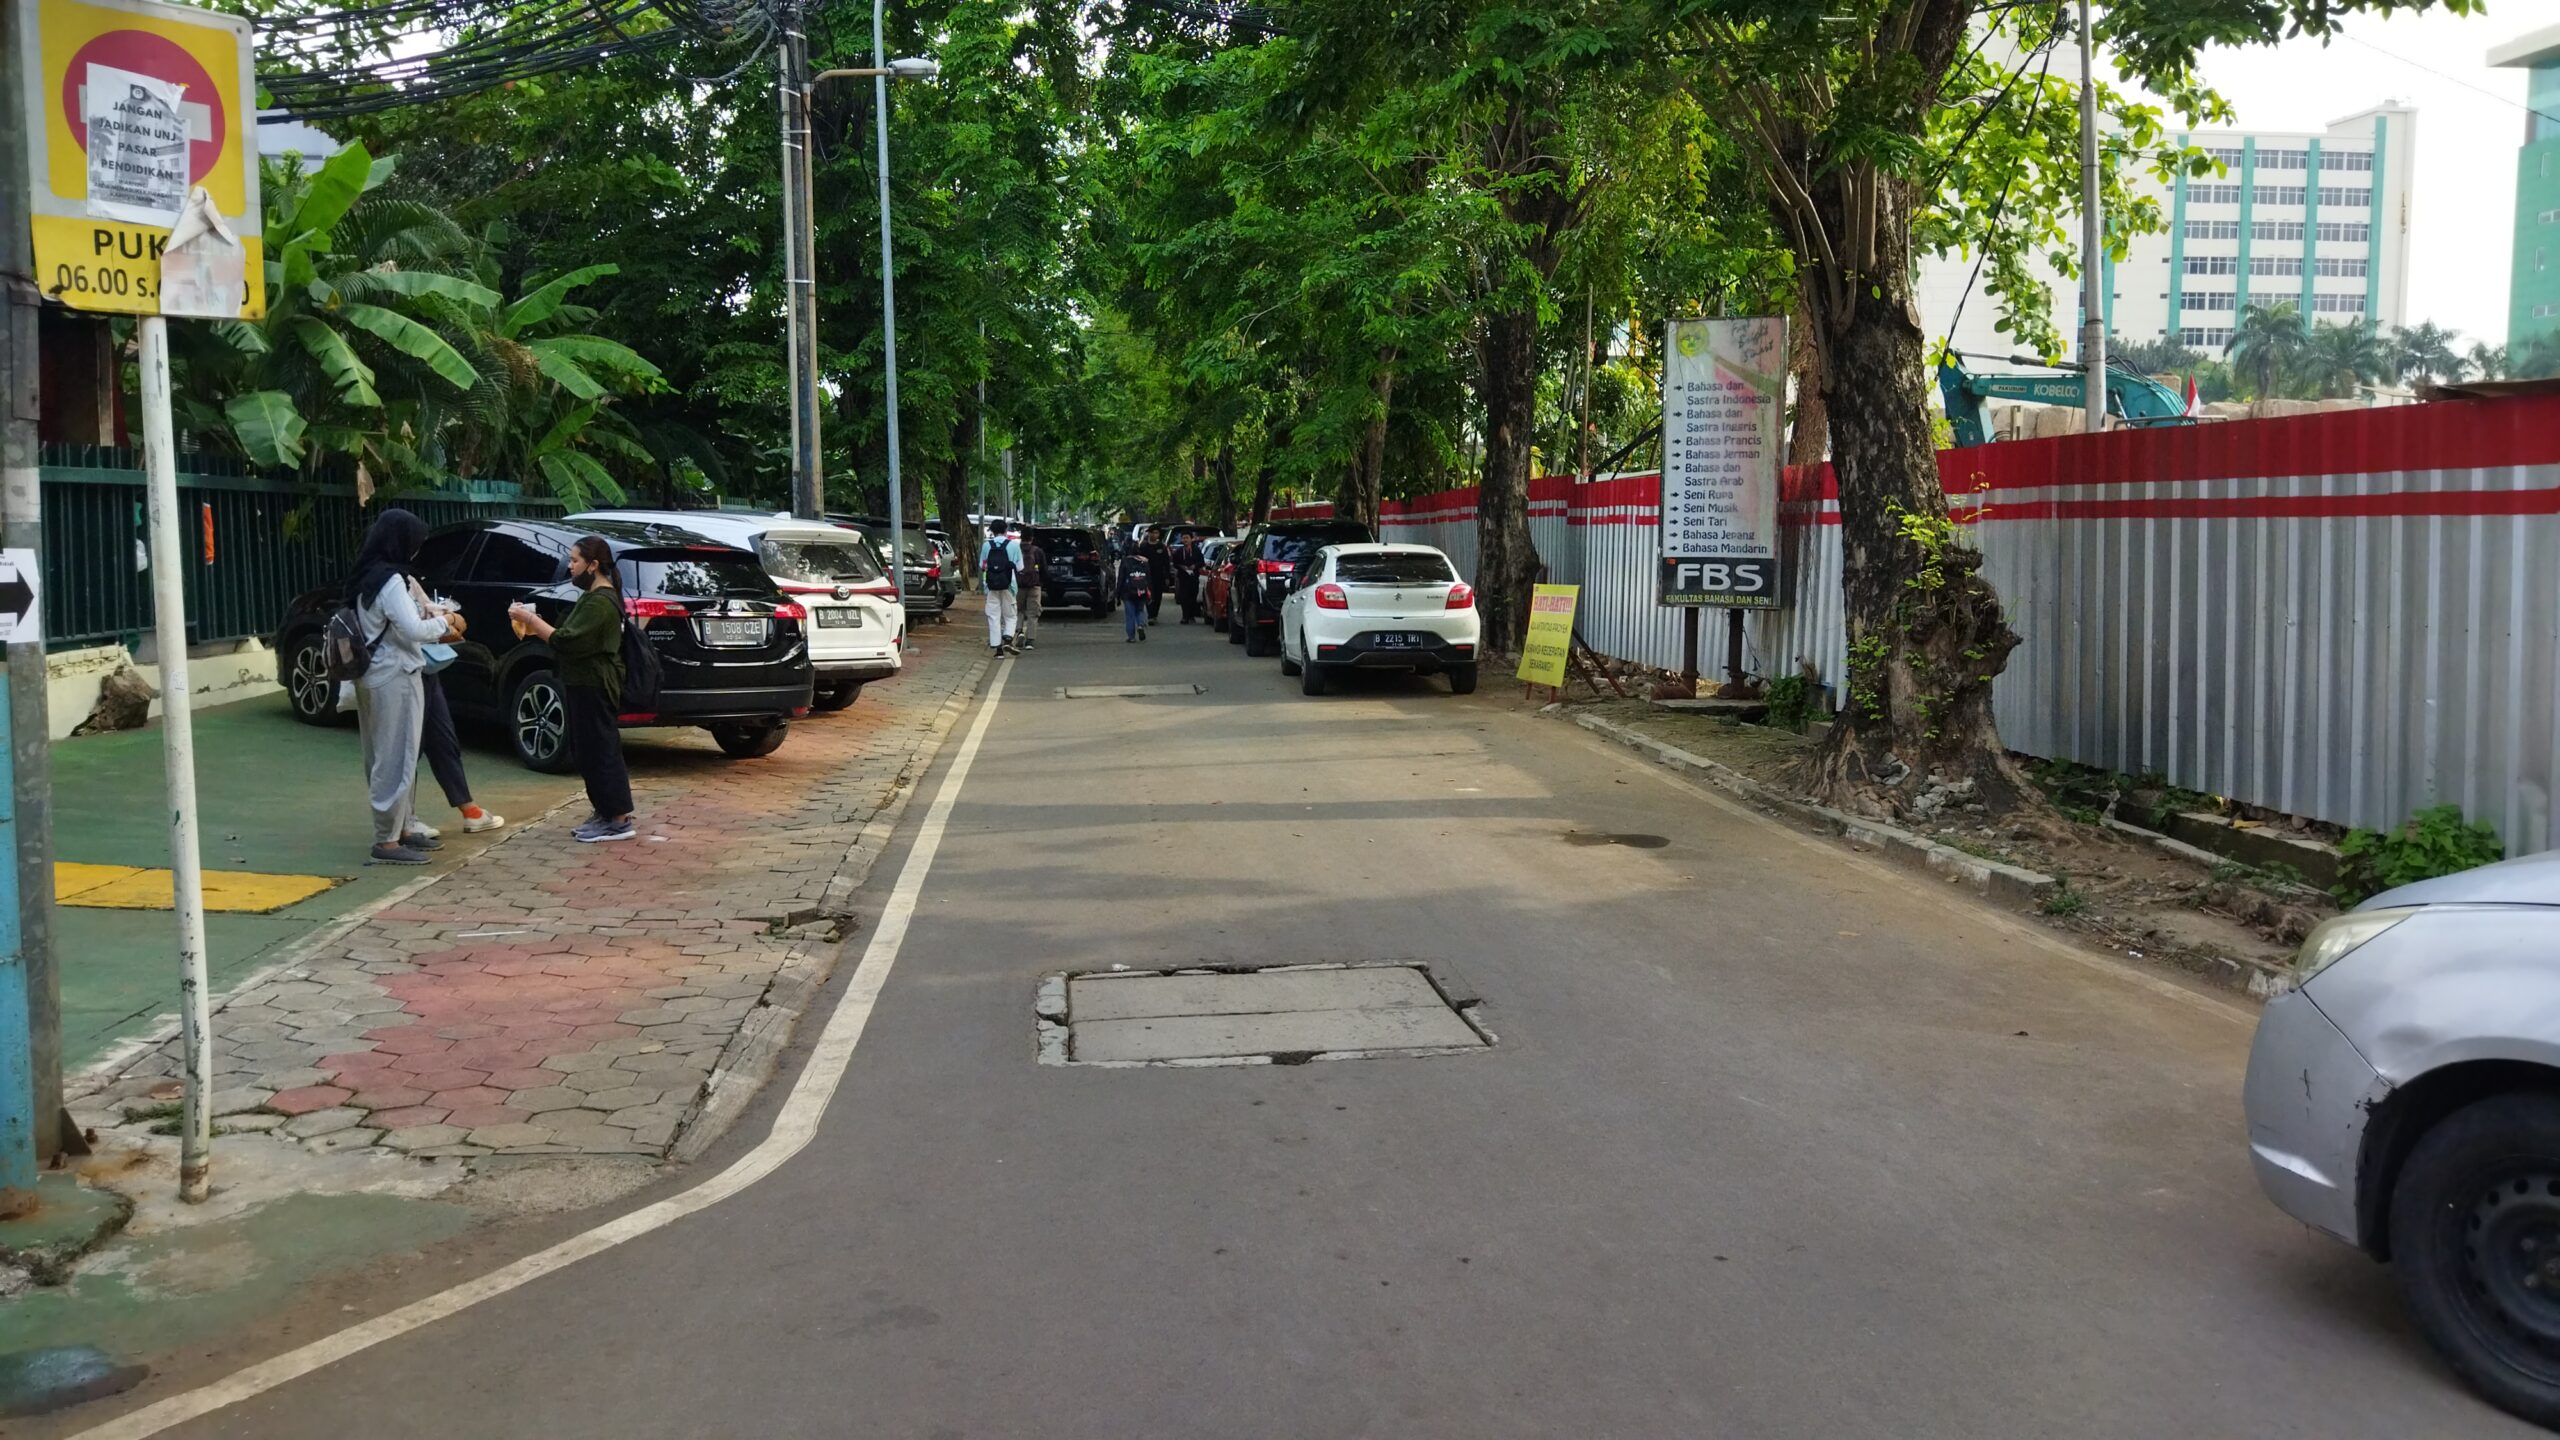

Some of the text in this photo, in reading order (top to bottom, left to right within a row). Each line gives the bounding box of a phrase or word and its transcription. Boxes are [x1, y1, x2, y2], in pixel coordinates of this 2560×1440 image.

[113, 101, 162, 120] JANGAN
[99, 119, 177, 142] JADIKAN UNJ
[118, 142, 157, 157] PASAR
[101, 158, 174, 180] PENDIDIKAN
[94, 229, 169, 260] PUK
[57, 263, 161, 298] 06.00 s.
[1687, 381, 1745, 392] Bahasa dan
[2034, 383, 2080, 398] KOBELCO
[1687, 394, 1771, 406] Sastra Indonesia
[1687, 408, 1743, 419] Bahasa dan
[1686, 423, 1719, 433] Sastra
[1686, 436, 1762, 446] Bahasa Prancis
[1686, 449, 1760, 459] Bahasa Jerman
[1685, 463, 1741, 473] Bahasa dan
[1684, 476, 1744, 486] Sastra Arab
[1684, 490, 1734, 500] Seni Rupa
[1683, 503, 1738, 513] Seni Musik
[1683, 516, 1727, 526] Seni Tari
[1683, 530, 1755, 540] Bahasa Jepang
[1682, 543, 1768, 554] Bahasa Mandarin
[1677, 563, 1764, 592] FBS
[1666, 594, 1772, 605] FAKULTAS BAHASA DAN SENI
[704, 621, 761, 635] B 1508 CZE
[1375, 633, 1381, 643] B
